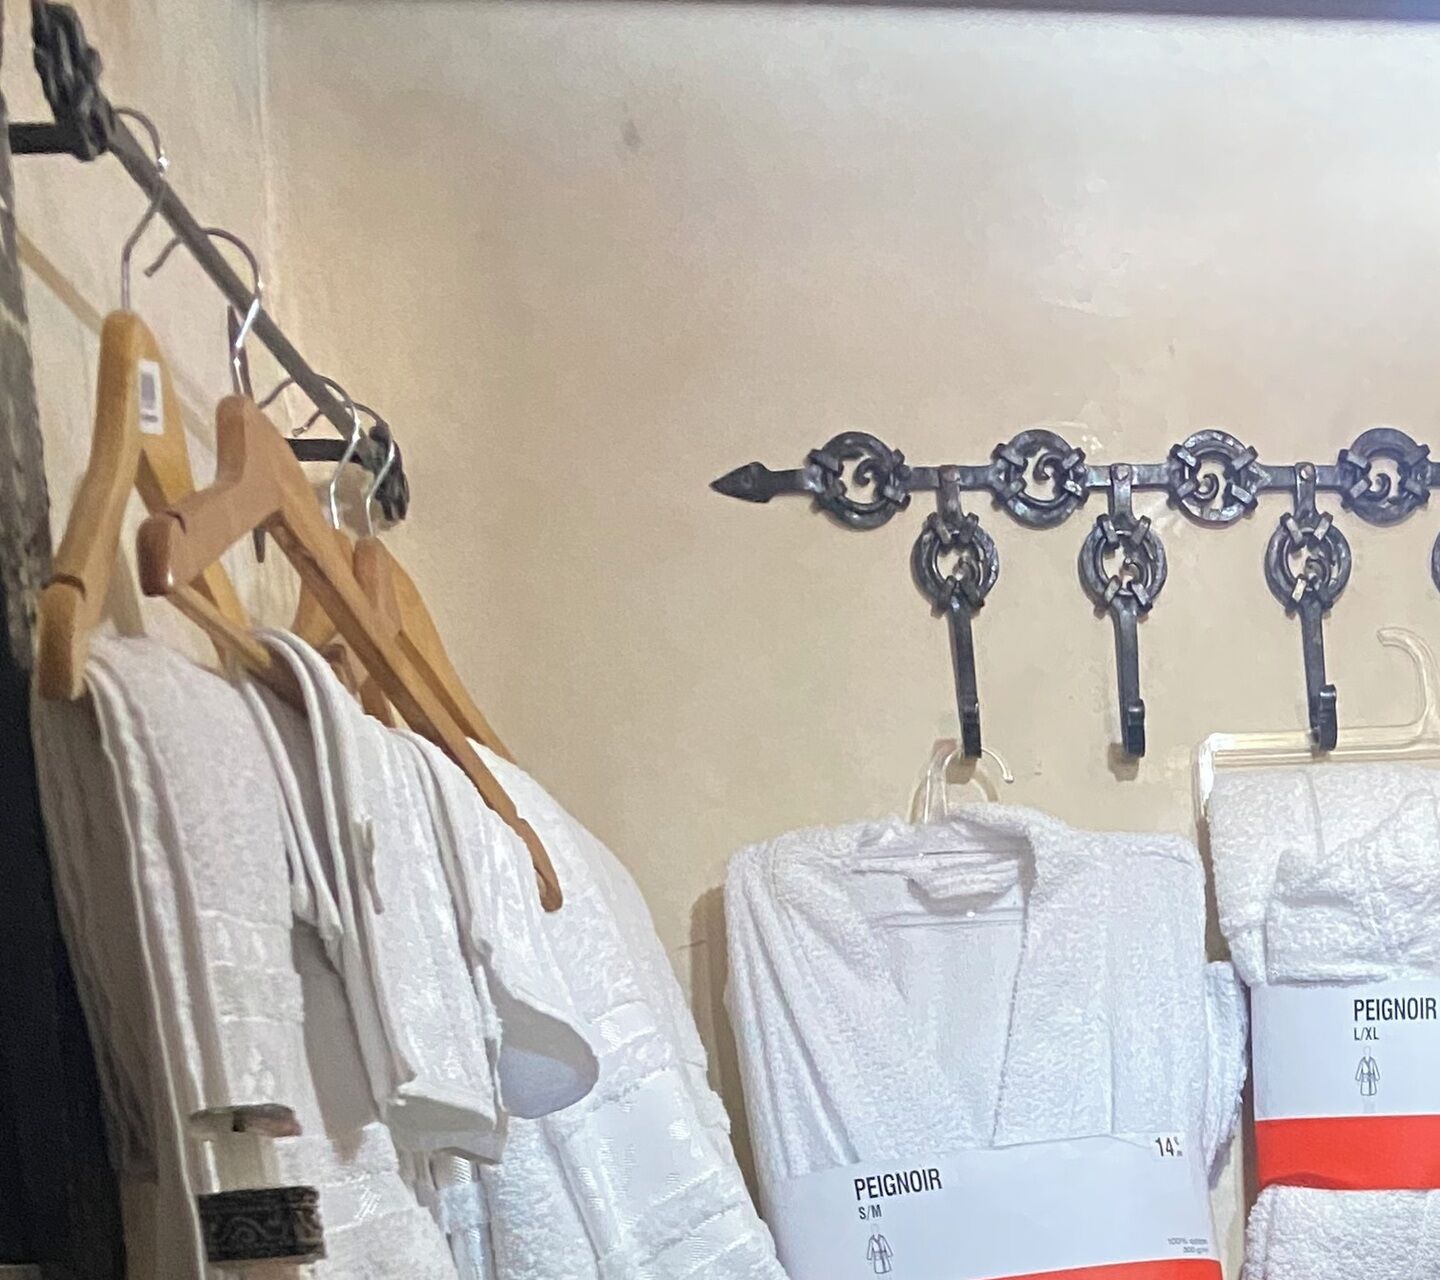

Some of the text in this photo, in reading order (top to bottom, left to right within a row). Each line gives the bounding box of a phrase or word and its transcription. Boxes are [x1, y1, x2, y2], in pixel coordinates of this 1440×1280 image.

[1354, 997, 1437, 1021] PEIGNOIR
[1354, 1026, 1380, 1041] L/XL
[854, 1168, 943, 1201] PEIGNOIR
[858, 1204, 882, 1221] S/M
